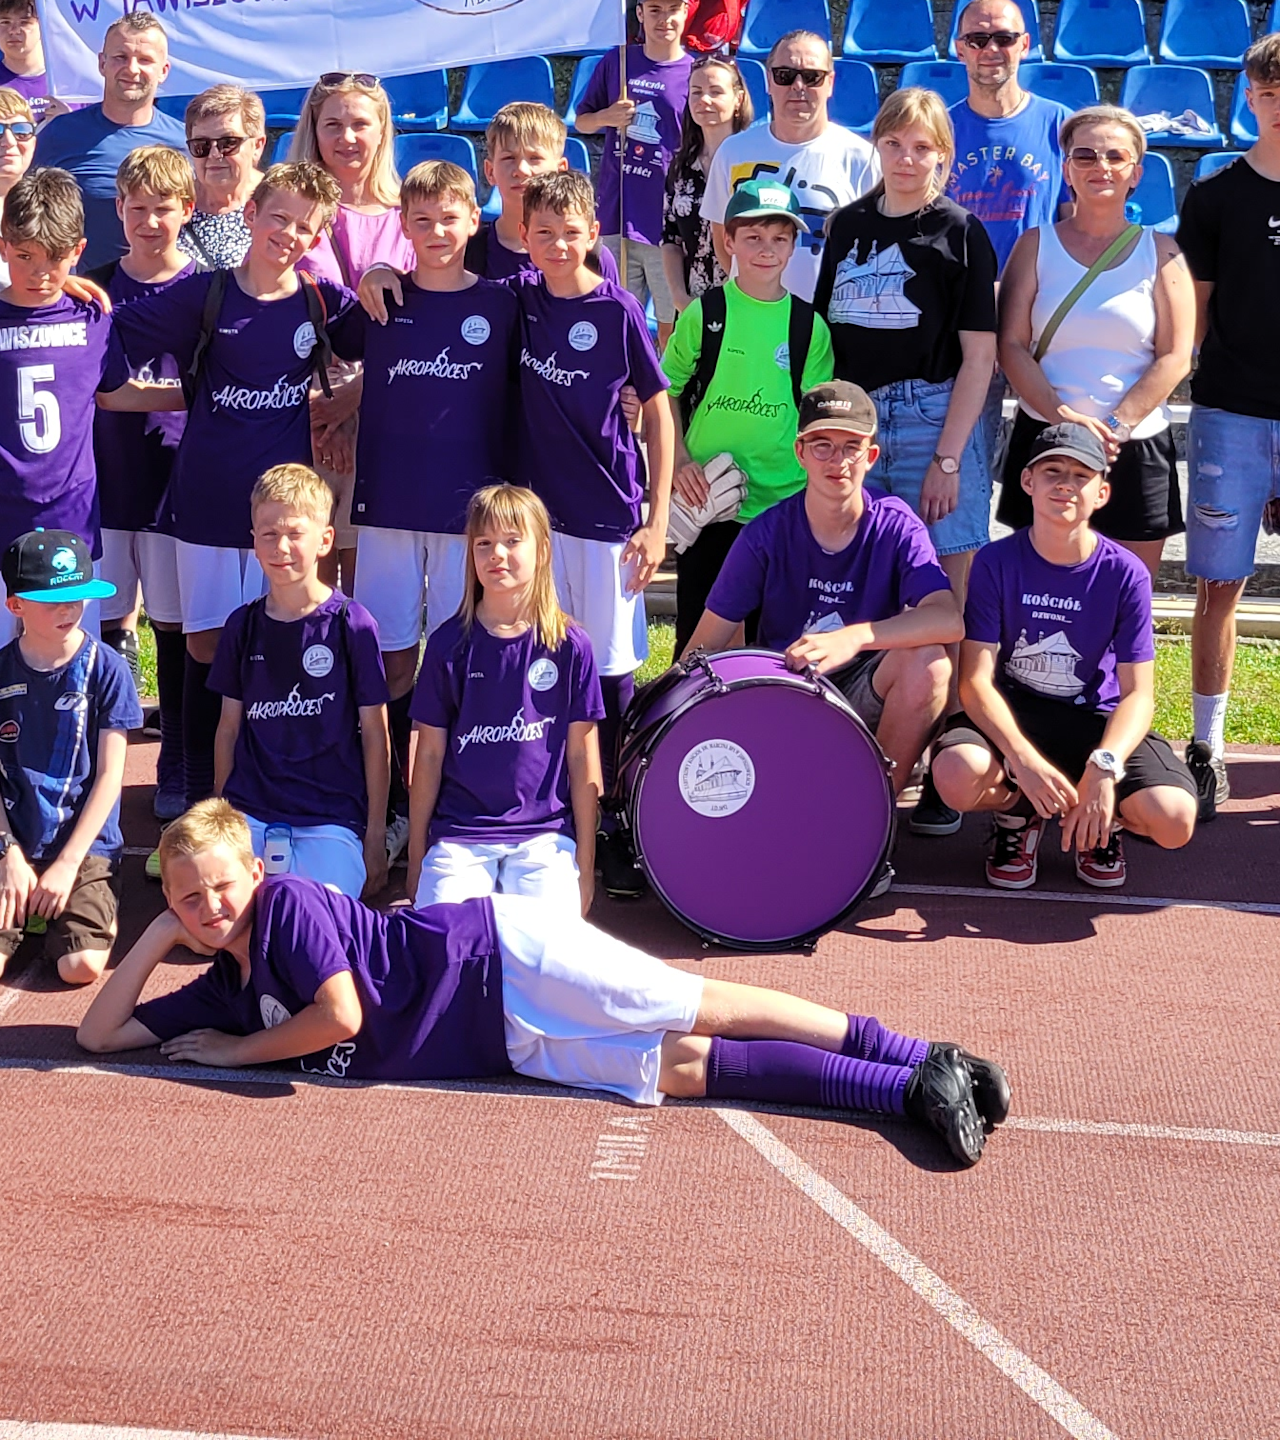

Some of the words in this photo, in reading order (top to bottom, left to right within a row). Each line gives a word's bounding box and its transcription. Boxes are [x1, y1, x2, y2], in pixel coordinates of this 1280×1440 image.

[392, 351, 476, 382] AKROPROCES
[16, 364, 62, 454] 5
[707, 391, 783, 418] AKROPROCES
[1022, 592, 1082, 611] KOŚCIÓŁ
[247, 690, 327, 721] AKROPROCES
[463, 714, 549, 748] AKROPROCES
